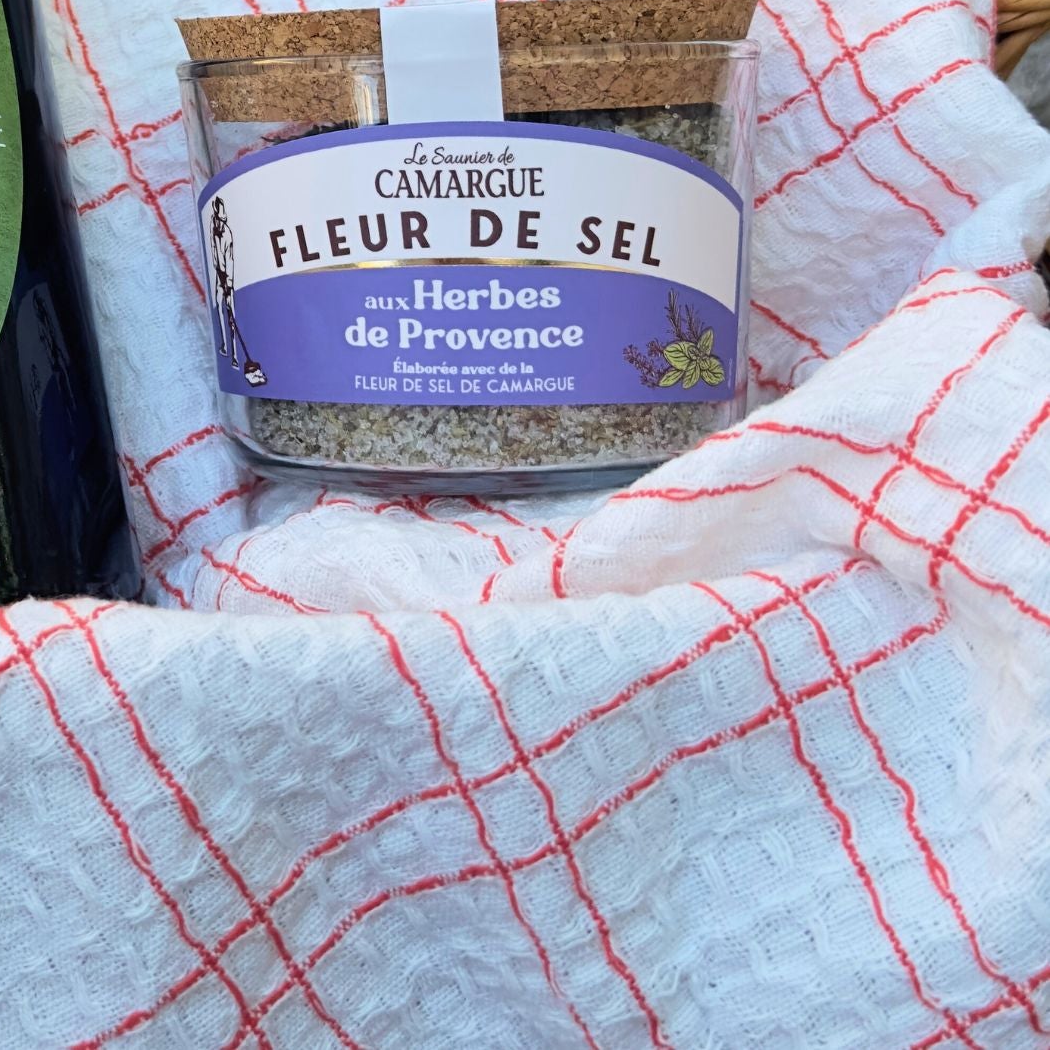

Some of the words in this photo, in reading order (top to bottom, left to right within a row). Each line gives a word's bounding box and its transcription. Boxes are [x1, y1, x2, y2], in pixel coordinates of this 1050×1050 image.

[404, 142, 427, 165] Le
[432, 146, 495, 165] Saunier
[497, 145, 514, 166] de
[374, 167, 545, 199] CAMARGUE
[269, 209, 431, 268] FLEUR
[470, 208, 540, 249] DE
[576, 216, 661, 267] SEL
[365, 295, 410, 310] aux
[413, 279, 562, 310] Herbes
[345, 316, 389, 348] de
[399, 318, 583, 350] Provence
[393, 356, 458, 375] Élaborée
[461, 365, 495, 375] avec
[499, 362, 517, 374] de
[520, 362, 534, 374] la
[355, 375, 397, 391] FLEUR
[403, 378, 422, 392] DE
[428, 379, 454, 393] SEL
[461, 379, 481, 393] DE
[487, 376, 575, 393] CAMARGUE
